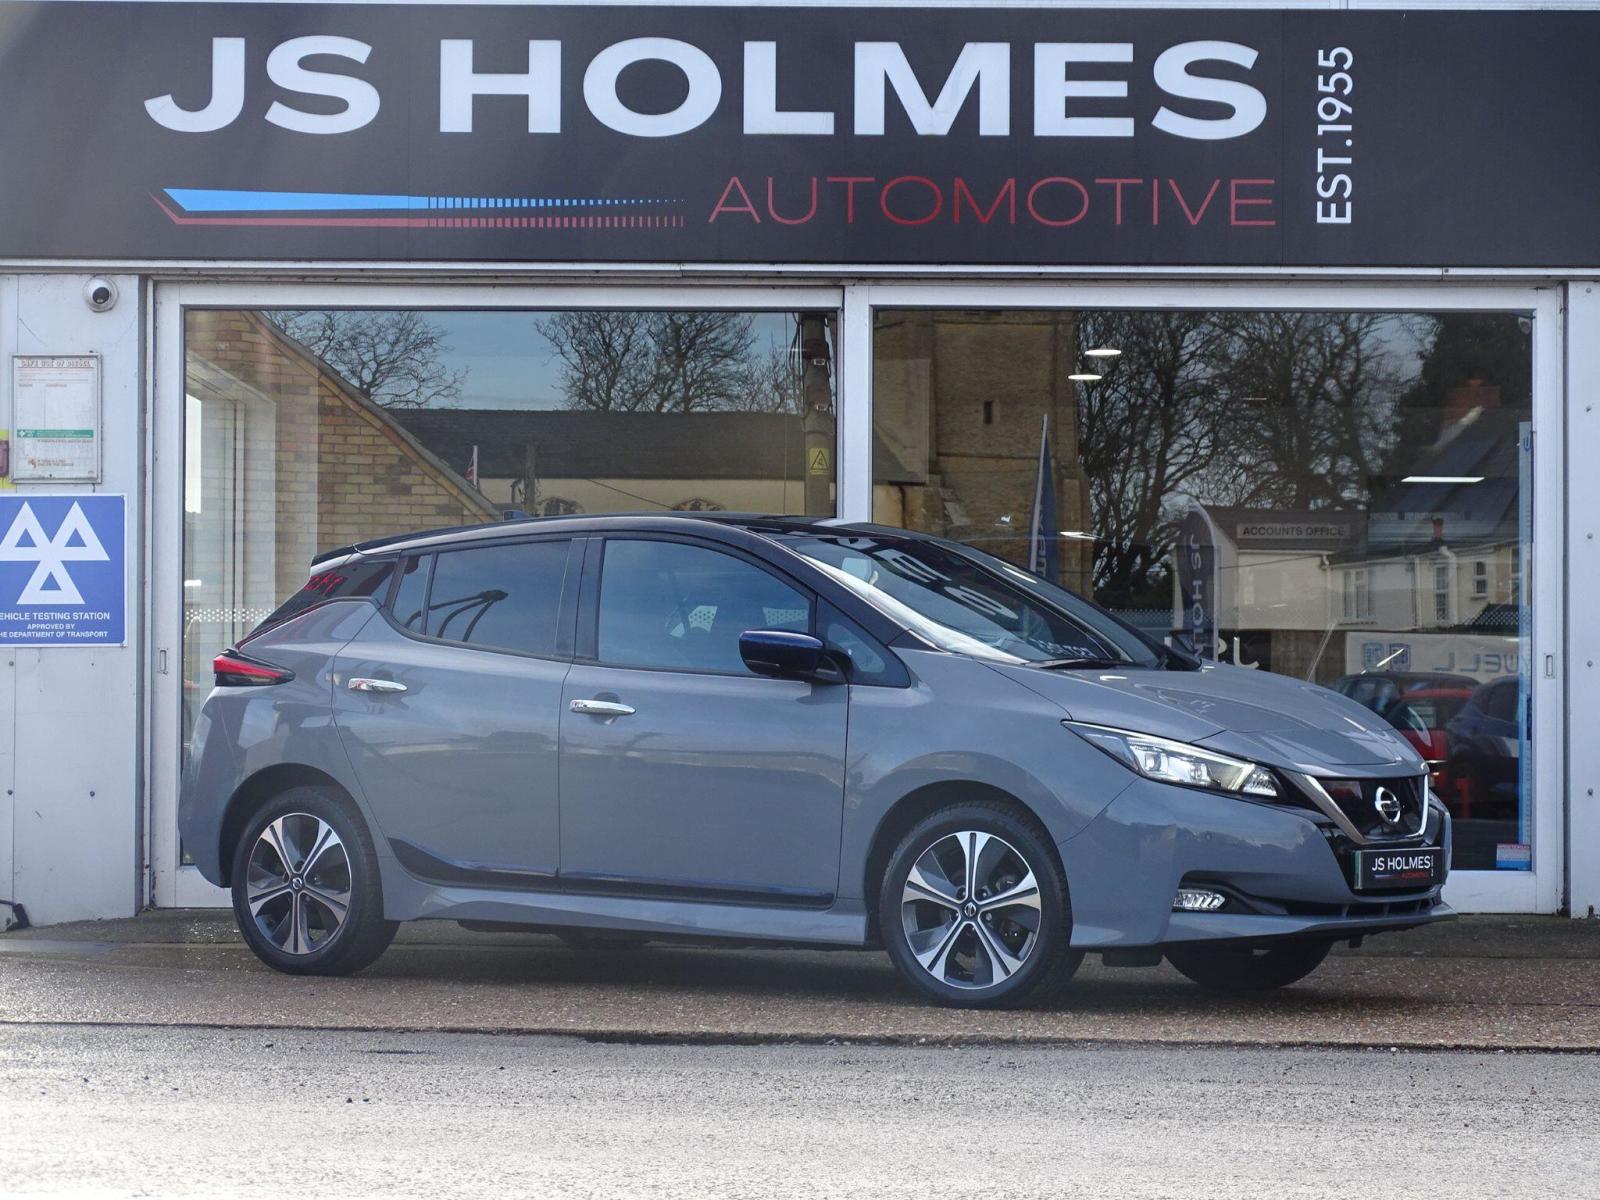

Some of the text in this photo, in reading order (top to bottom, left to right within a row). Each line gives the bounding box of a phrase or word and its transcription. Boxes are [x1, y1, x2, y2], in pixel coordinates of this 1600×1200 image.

[144, 35, 1268, 140] JS HOLMES
[1316, 45, 1354, 225] EST.1955
[708, 175, 1277, 227] AUTOMOTIVE
[1242, 526, 1303, 536] ACCOUNTS
[0, 612, 111, 621] EHICLE TESTING STATION
[1371, 857, 1385, 871] JS
[1387, 855, 1431, 870] HOLMES
